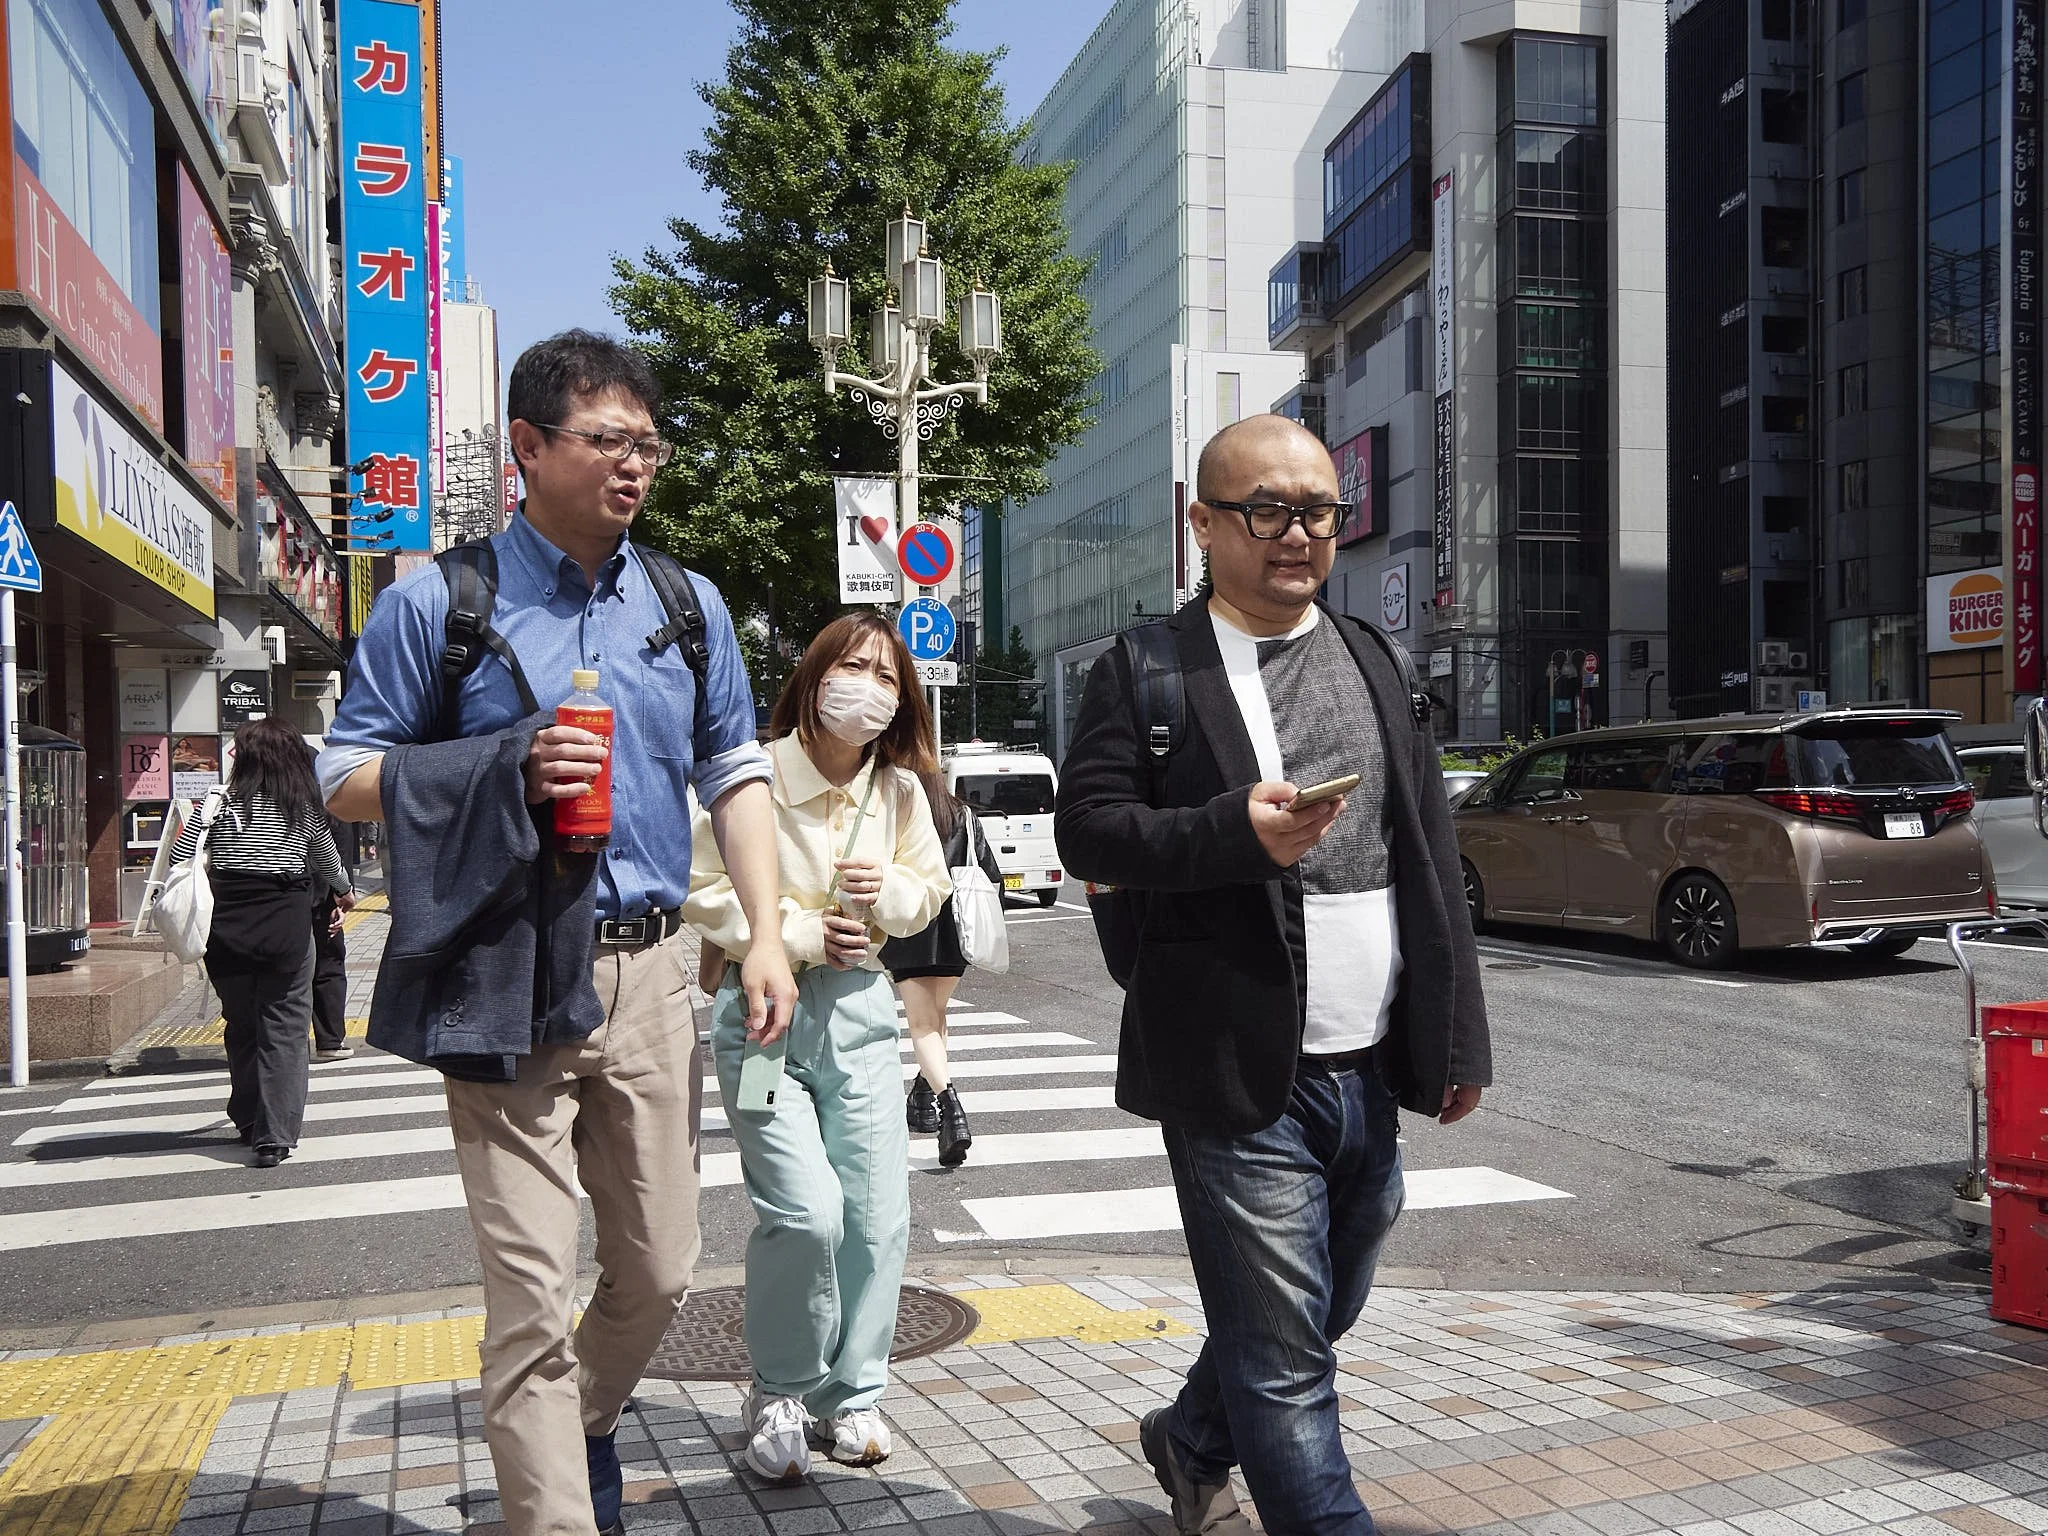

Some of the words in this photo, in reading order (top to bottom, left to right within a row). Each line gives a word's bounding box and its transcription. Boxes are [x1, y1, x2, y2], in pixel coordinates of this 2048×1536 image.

[2014, 136, 2027, 207] ともしび
[26, 182, 61, 320] H
[354, 40, 418, 508] カラオケ館
[2017, 249, 2034, 310] Euphoria
[65, 281, 106, 364] Clinic
[109, 332, 158, 421] Shinjuku
[506, 475, 516, 506] ガスト
[2015, 488, 2035, 497] KING
[846, 516, 859, 545] I
[915, 525, 936, 533] 20-7
[135, 540, 164, 581] LIQUOR
[167, 562, 185, 595] SHOP
[847, 581, 894, 592] 歌舞伎町
[1383, 592, 1405, 608] スシロー
[2016, 509, 2034, 668] バーガーキング
[914, 600, 940, 612] 1-20
[1949, 592, 2003, 613] BURGER
[911, 612, 934, 650] P
[1949, 607, 2003, 633] KING
[1734, 672, 1748, 684] PUB
[222, 698, 265, 706] TRIBAL
[1910, 822, 1922, 834] 88
